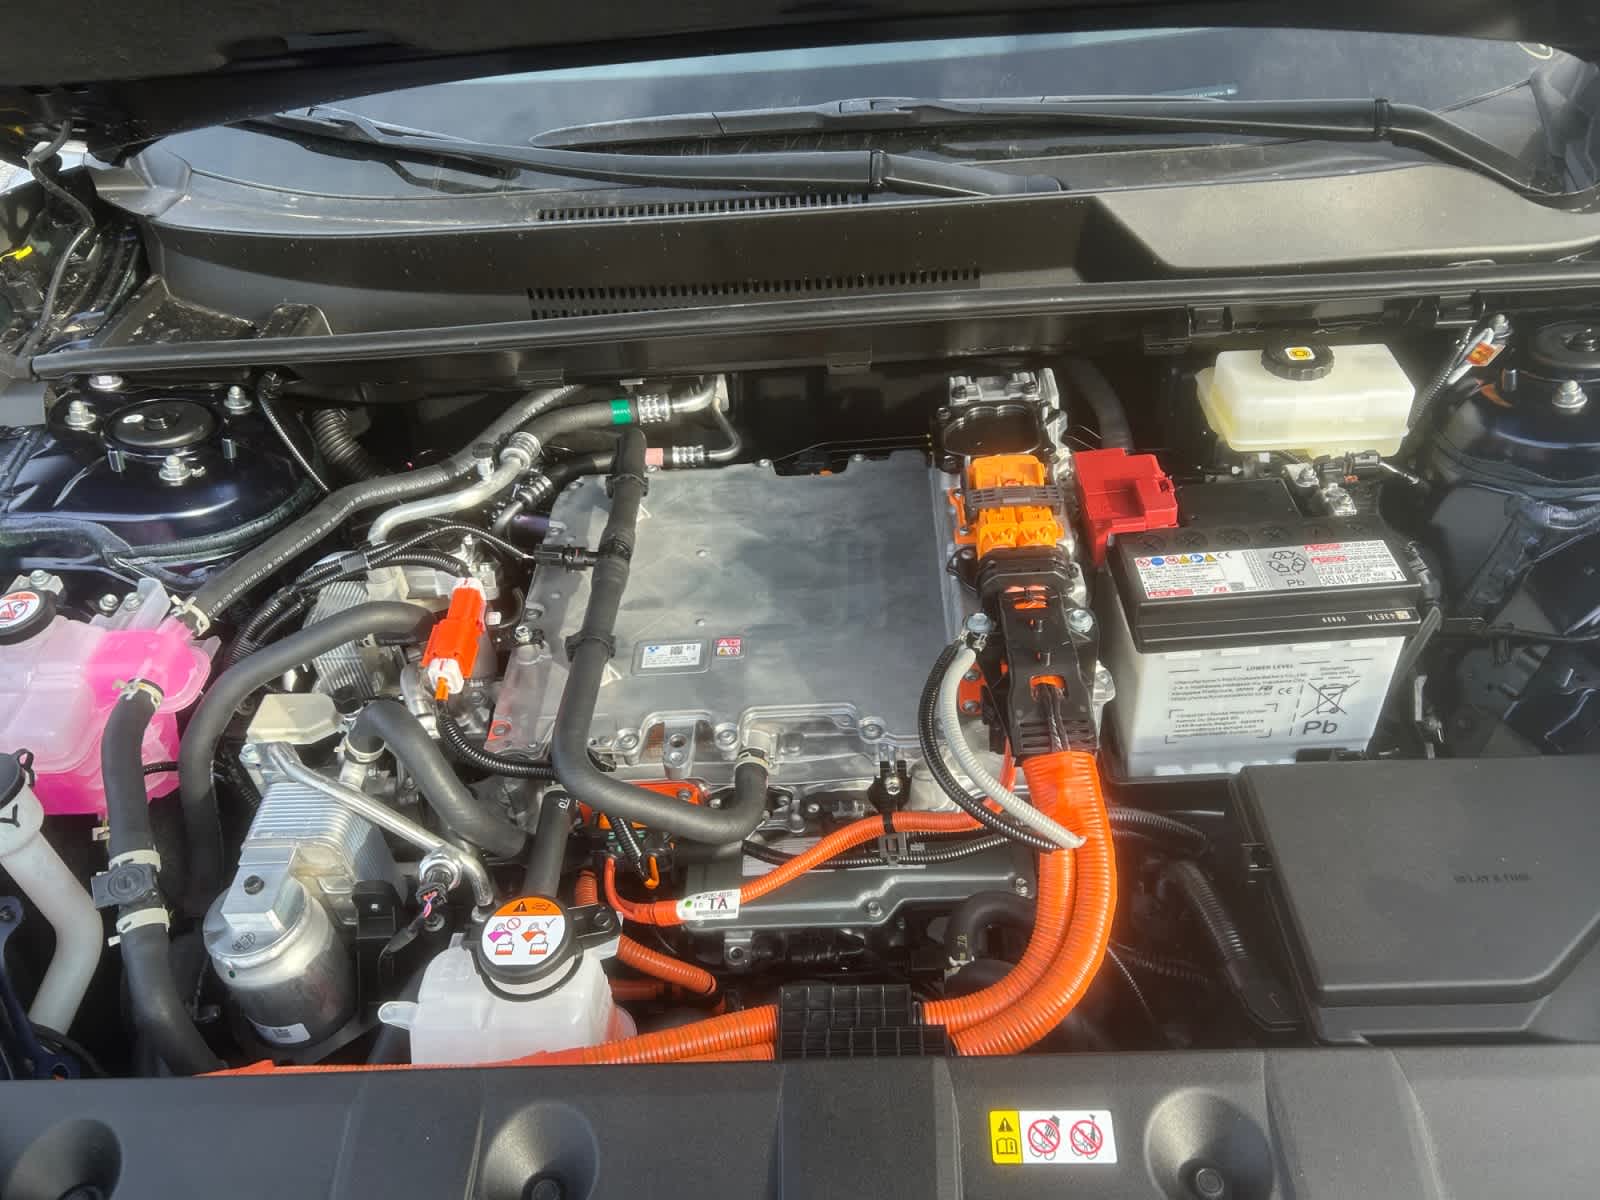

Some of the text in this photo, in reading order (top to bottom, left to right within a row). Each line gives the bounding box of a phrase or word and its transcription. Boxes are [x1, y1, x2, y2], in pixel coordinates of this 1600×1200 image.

[1287, 579, 1306, 587] Pb
[1302, 719, 1338, 735] Pb
[709, 897, 728, 910] TA
